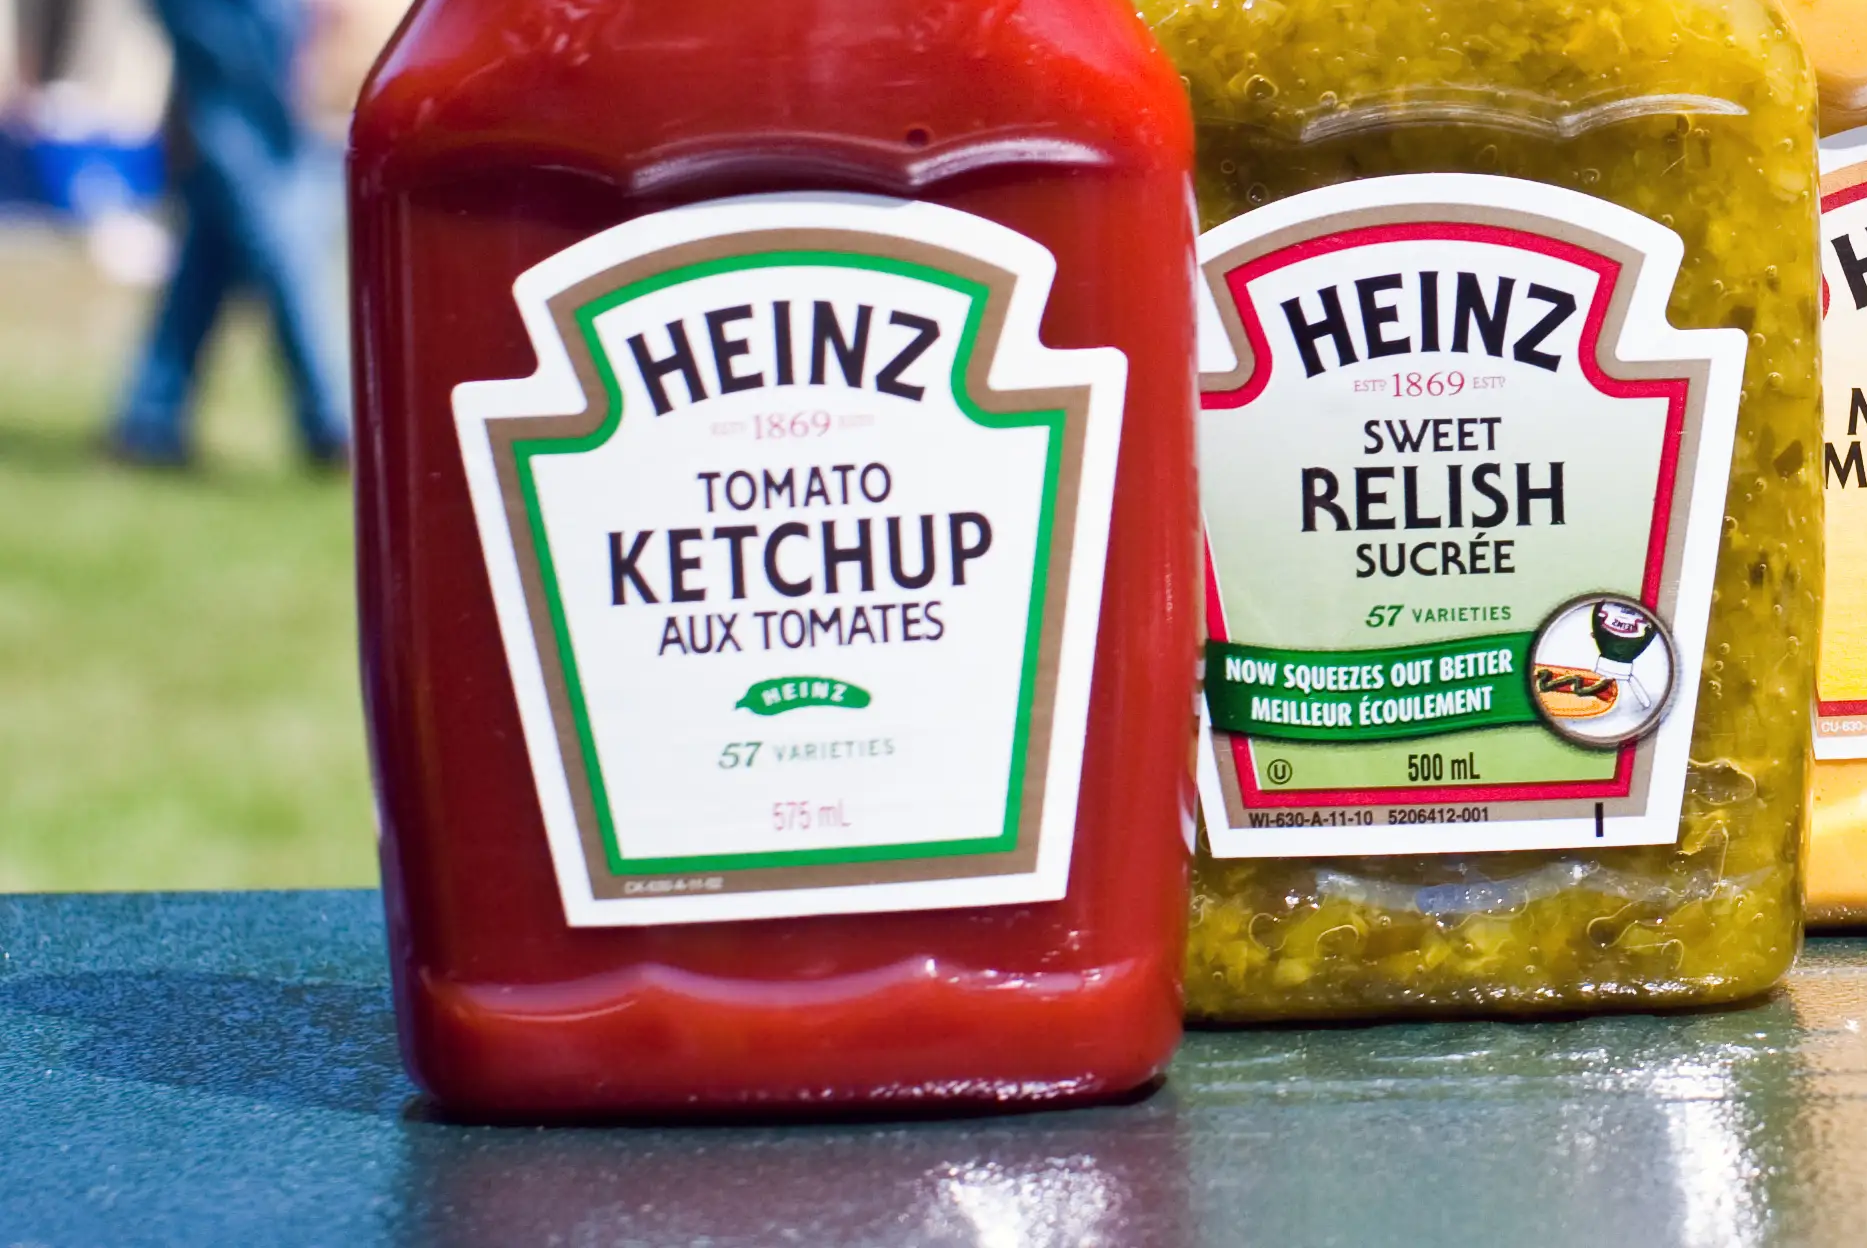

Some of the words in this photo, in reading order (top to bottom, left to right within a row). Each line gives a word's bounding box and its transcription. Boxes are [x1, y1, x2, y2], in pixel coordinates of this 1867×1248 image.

[1280, 270, 1577, 379] HEINZ
[626, 300, 940, 417] HEINZ
[1393, 371, 1464, 397] 1869
[754, 413, 831, 440] 1869
[1364, 417, 1501, 454] SWEET
[697, 463, 891, 512] TOMATO
[1301, 461, 1566, 532] RELISH
[607, 511, 992, 607] KETCHUP
[1357, 532, 1515, 578] SUCRÉE
[659, 613, 742, 656] AUX
[753, 601, 944, 649] TOMATES
[1366, 605, 1404, 627] 57
[1412, 606, 1511, 623] VARIETIES
[1225, 655, 1275, 687] NOW
[1283, 663, 1385, 691] SQUEEZES
[1392, 659, 1433, 687] OUT
[1439, 650, 1513, 678] BETTER
[761, 681, 848, 707] HEINZ
[1251, 696, 1351, 727] MEILLEUR
[1358, 686, 1493, 726] ÉCOULEMENT
[719, 742, 763, 768] 57
[772, 738, 896, 764] VARIETIES
[1408, 753, 1443, 781] 500
[1451, 752, 1480, 780] mL
[773, 801, 810, 831] 575
[816, 798, 852, 829] mL
[1250, 810, 1373, 828] WI-630-A-11-10
[1388, 807, 1489, 825] 5206412-001
